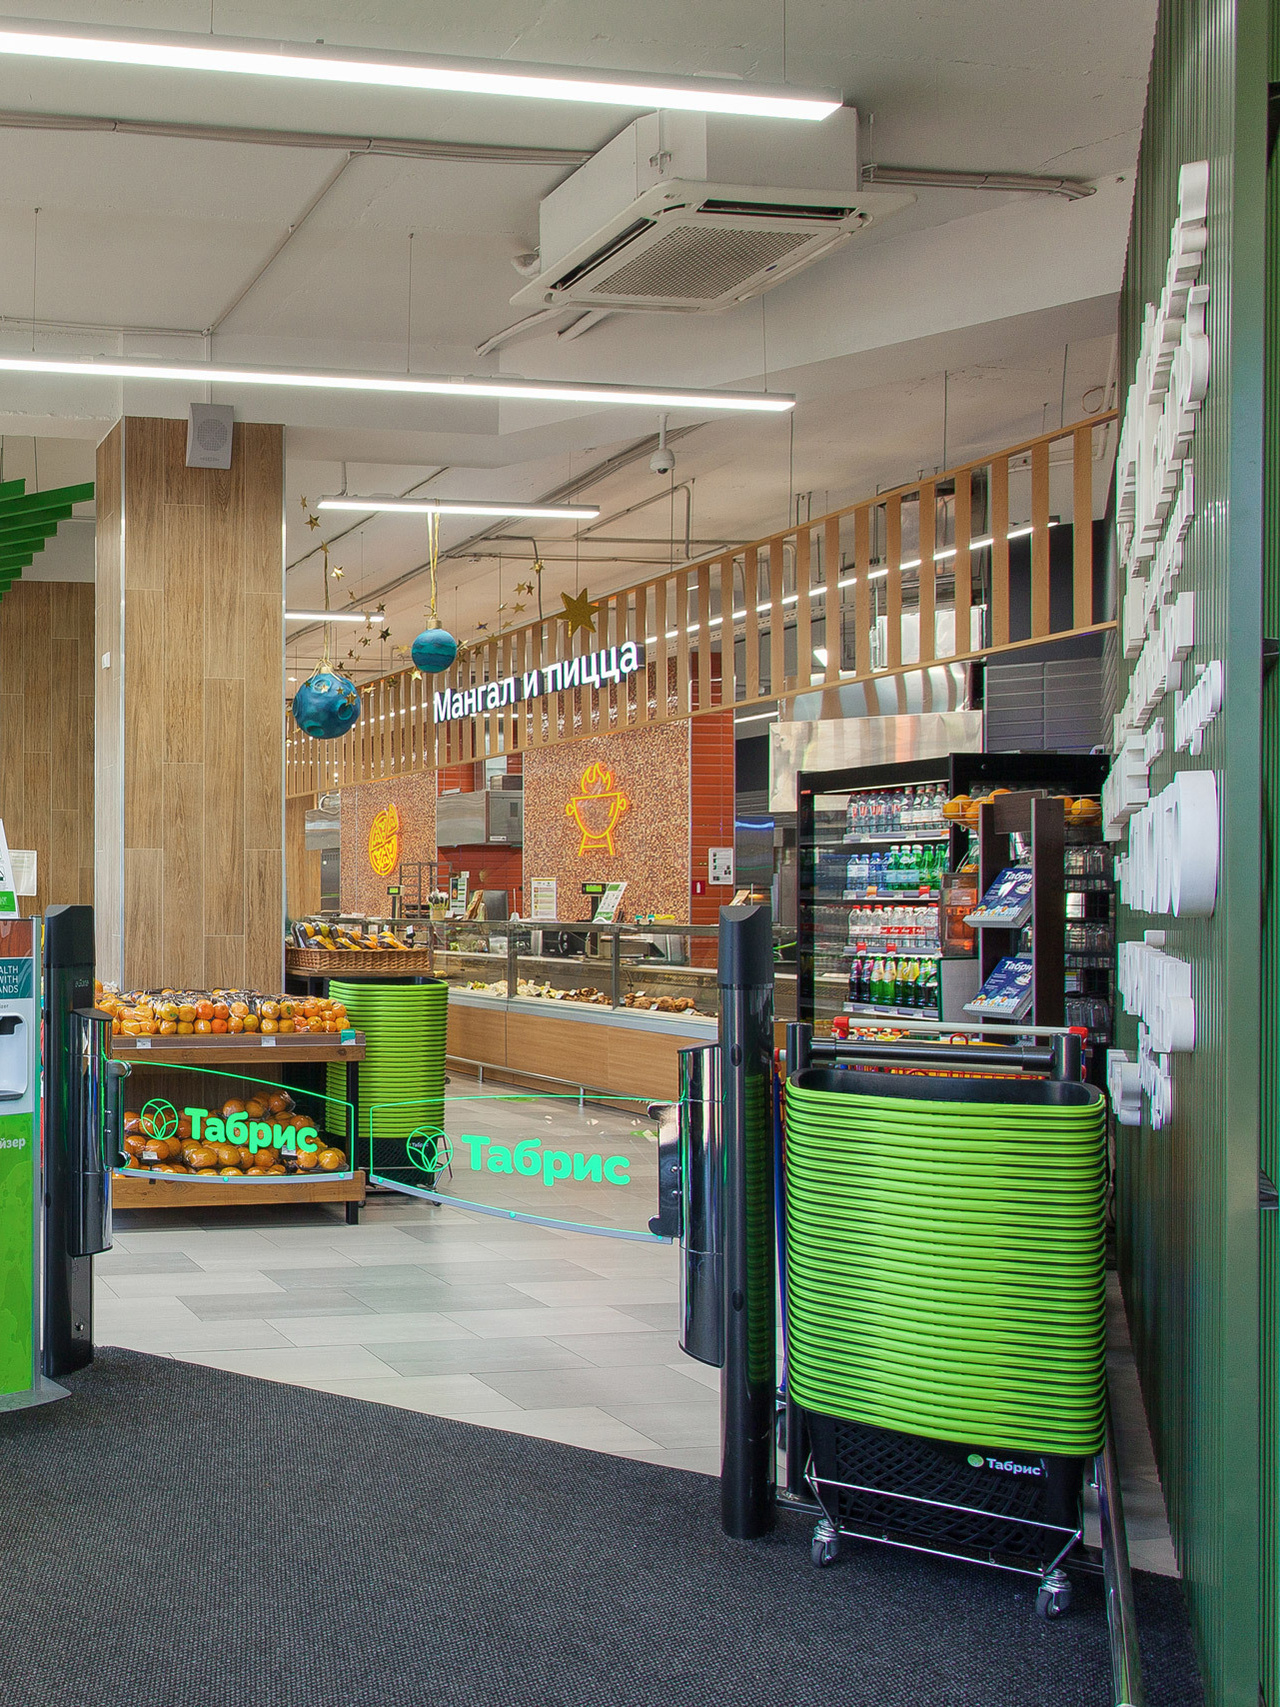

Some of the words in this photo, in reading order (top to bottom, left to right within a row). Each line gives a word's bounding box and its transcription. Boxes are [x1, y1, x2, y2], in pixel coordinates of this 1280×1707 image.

[433, 676, 516, 724] Мангал
[523, 669, 538, 699] и
[541, 641, 639, 693] пицца
[184, 1106, 318, 1154] Табрис
[461, 1134, 631, 1187] Табрис
[986, 1457, 1041, 1475] Табрис
